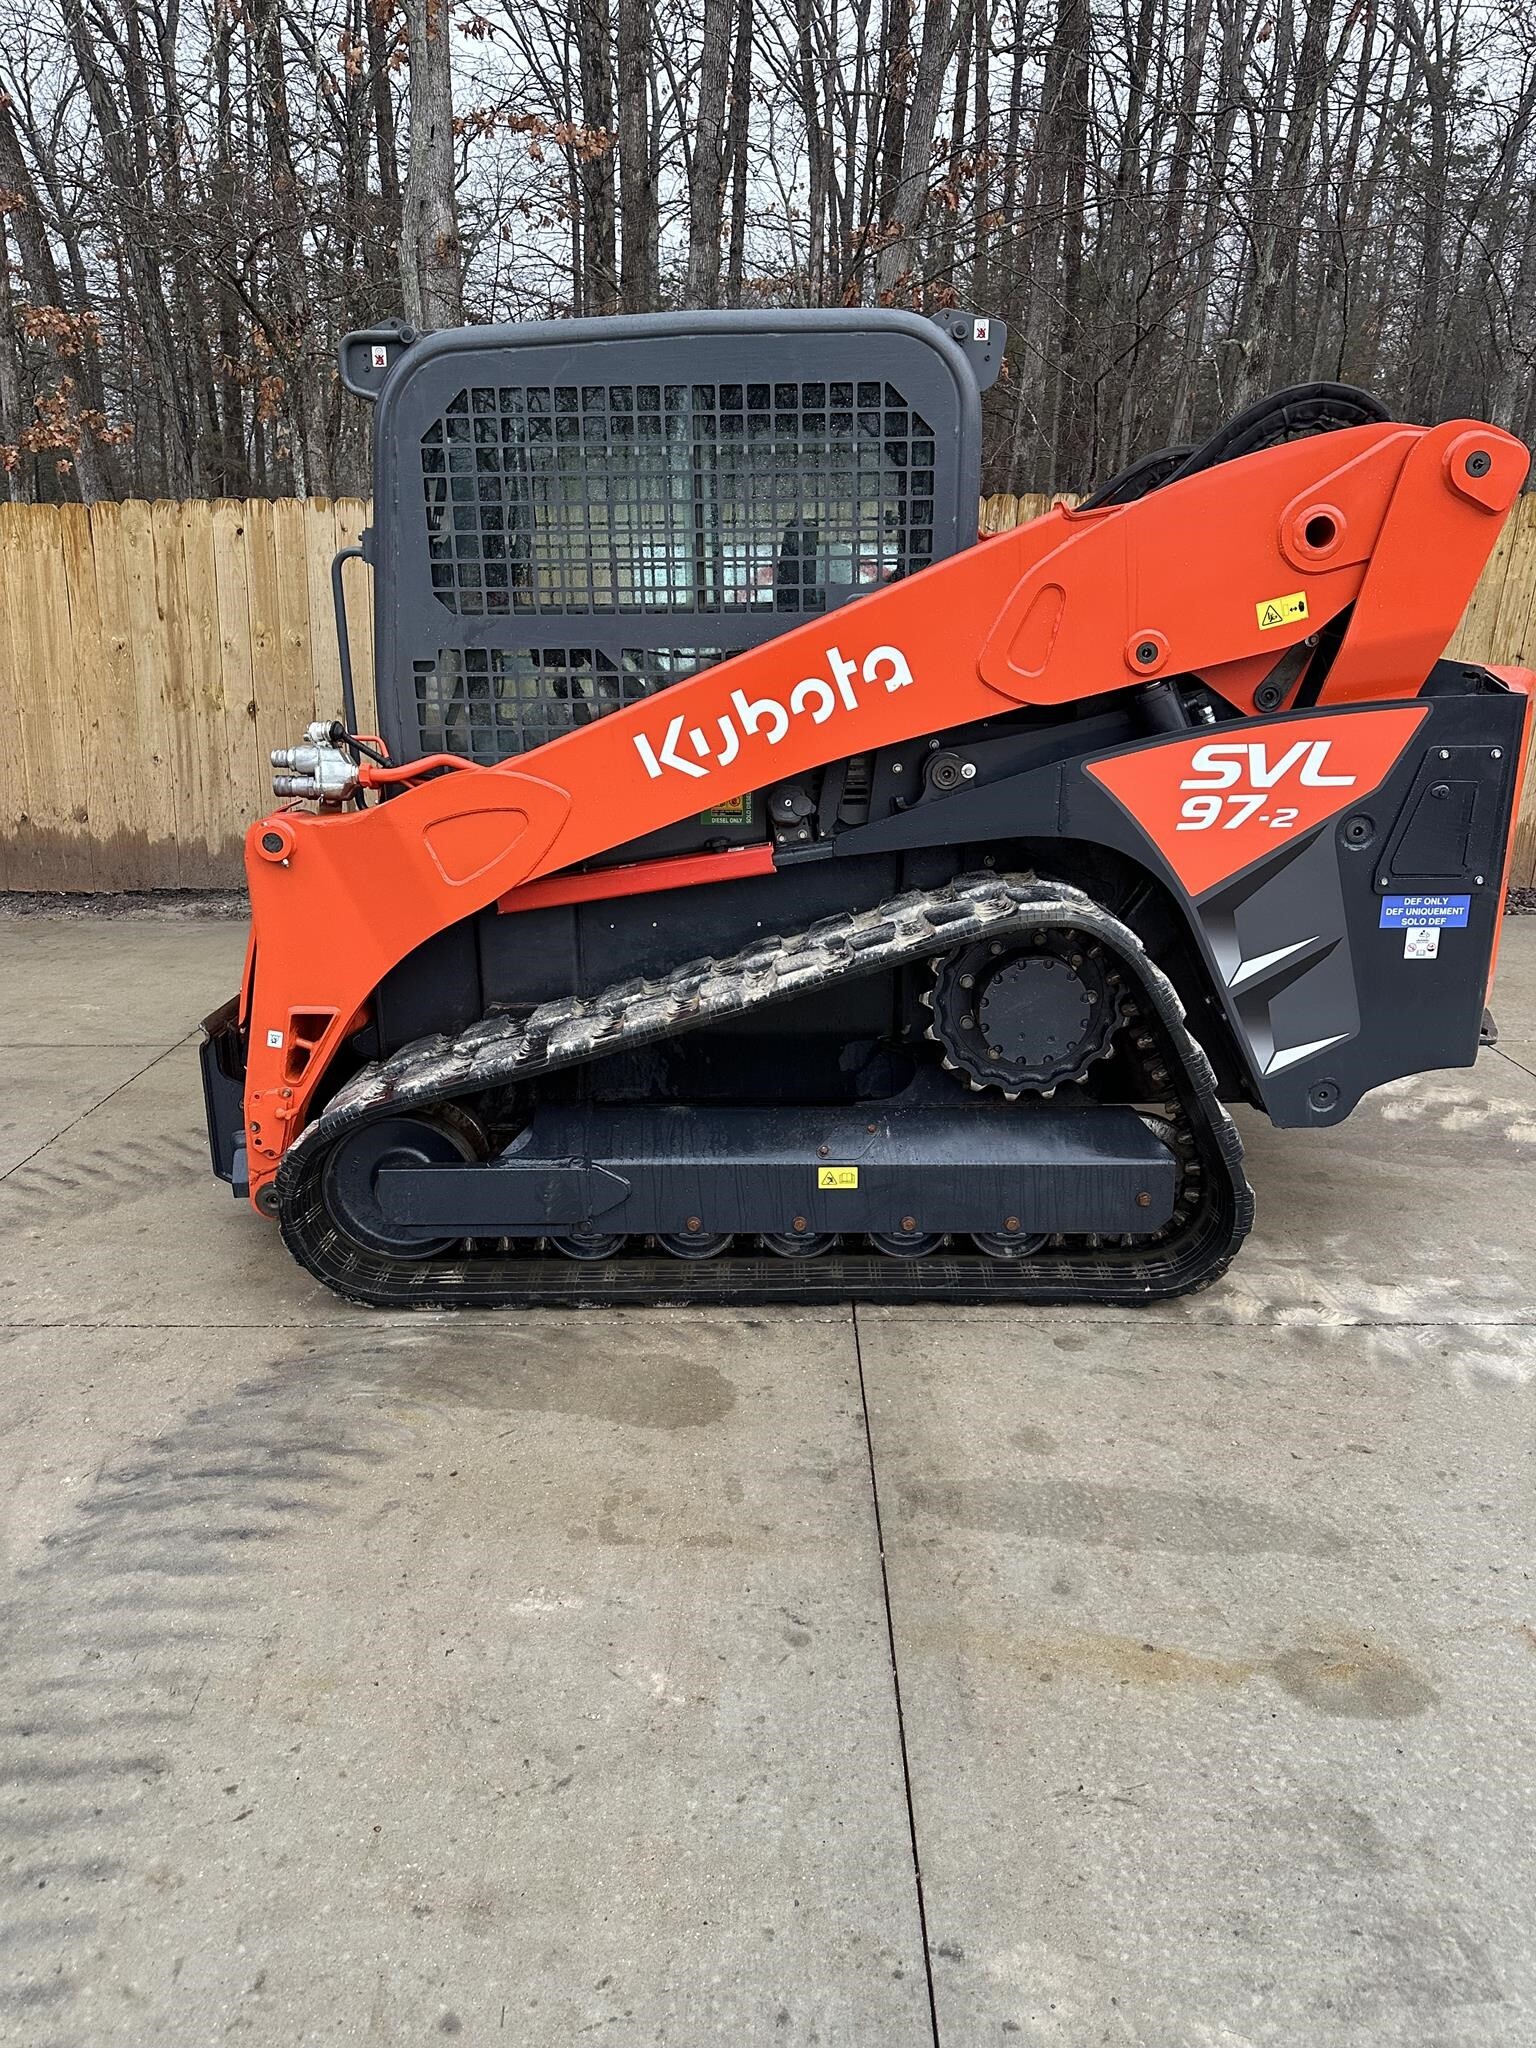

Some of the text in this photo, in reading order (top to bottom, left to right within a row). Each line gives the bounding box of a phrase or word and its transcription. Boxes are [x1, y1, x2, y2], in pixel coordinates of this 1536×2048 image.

[632, 646, 914, 779] Kubota
[1179, 740, 1357, 790] SVL
[1175, 793, 1299, 831] 97-2
[1385, 907, 1465, 916] DEF UNIQUEMENT
[1404, 897, 1449, 905] DEF ONLY
[1401, 917, 1447, 926] SOLO DEF
